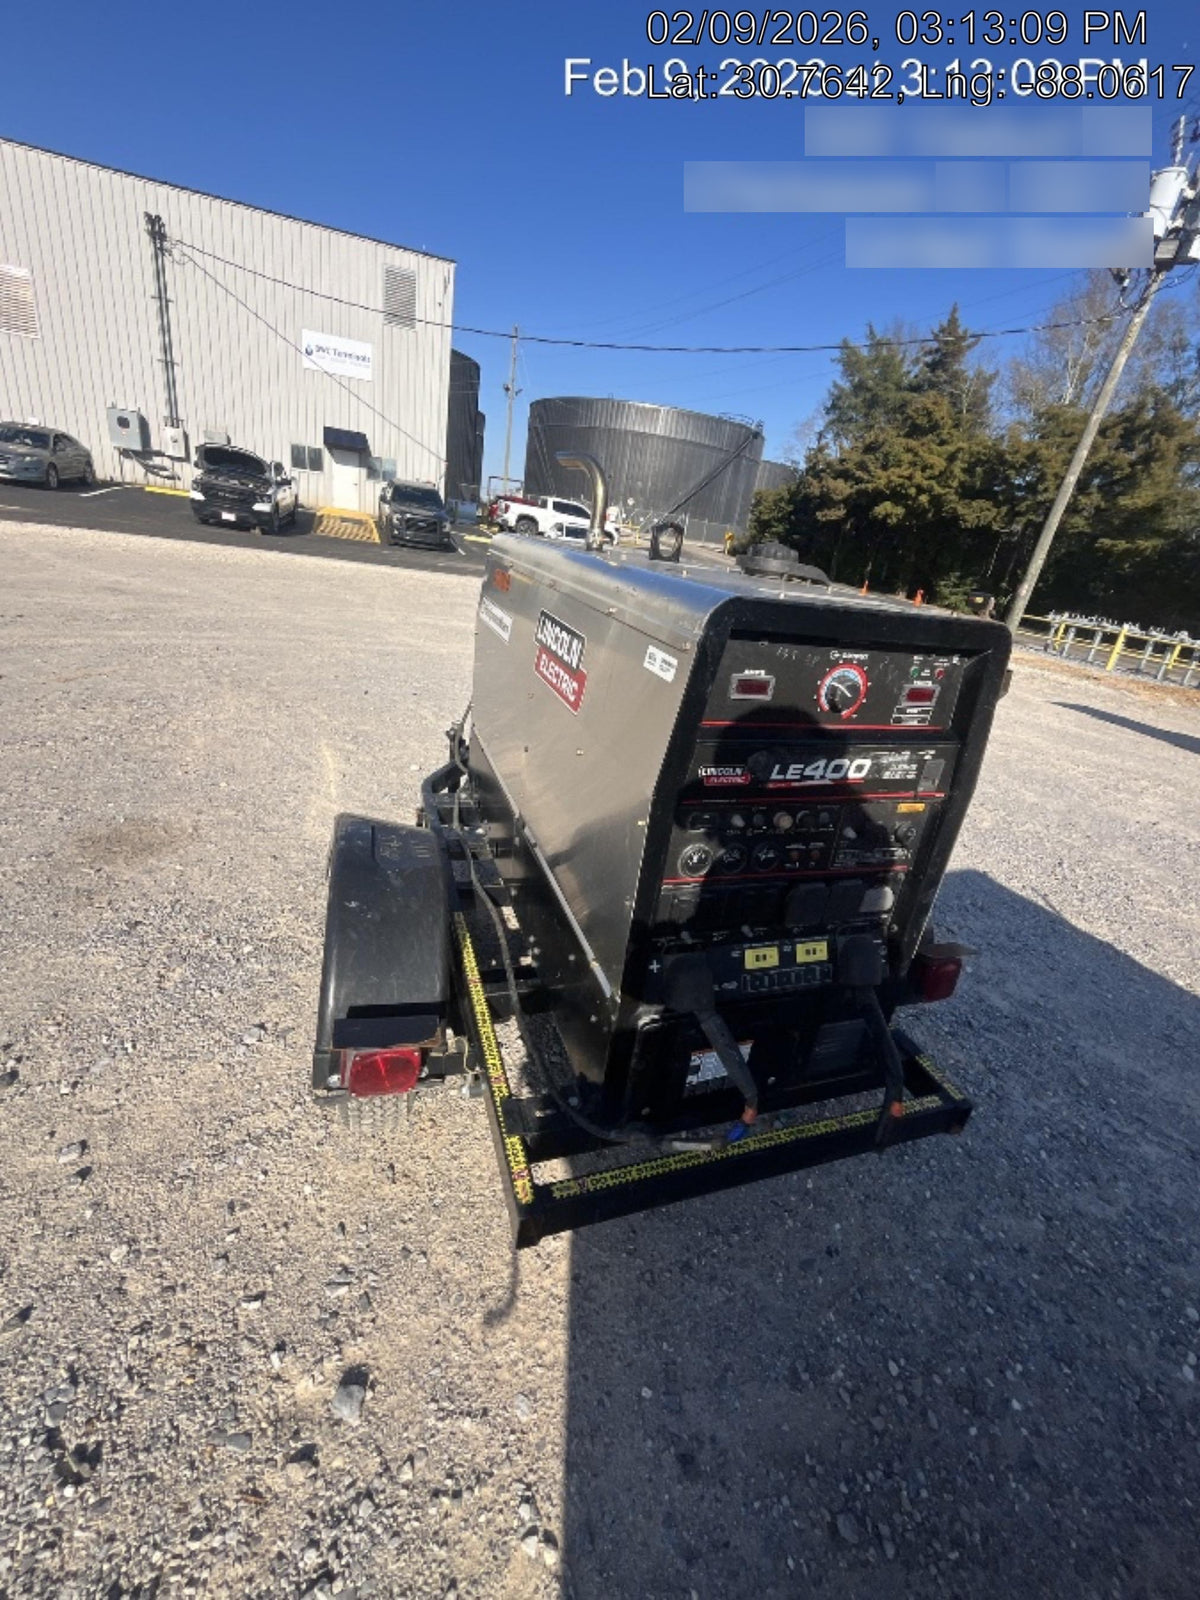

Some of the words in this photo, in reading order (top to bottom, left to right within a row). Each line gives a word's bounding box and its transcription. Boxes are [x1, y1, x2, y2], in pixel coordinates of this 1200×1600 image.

[537, 616, 583, 670] LINCOLN
[540, 653, 579, 702] ELECTRIC
[701, 766, 743, 776] LINCOLN
[769, 758, 872, 780] LE400
[590, 1176, 607, 1187] DO
[609, 1171, 634, 1181] NOT
